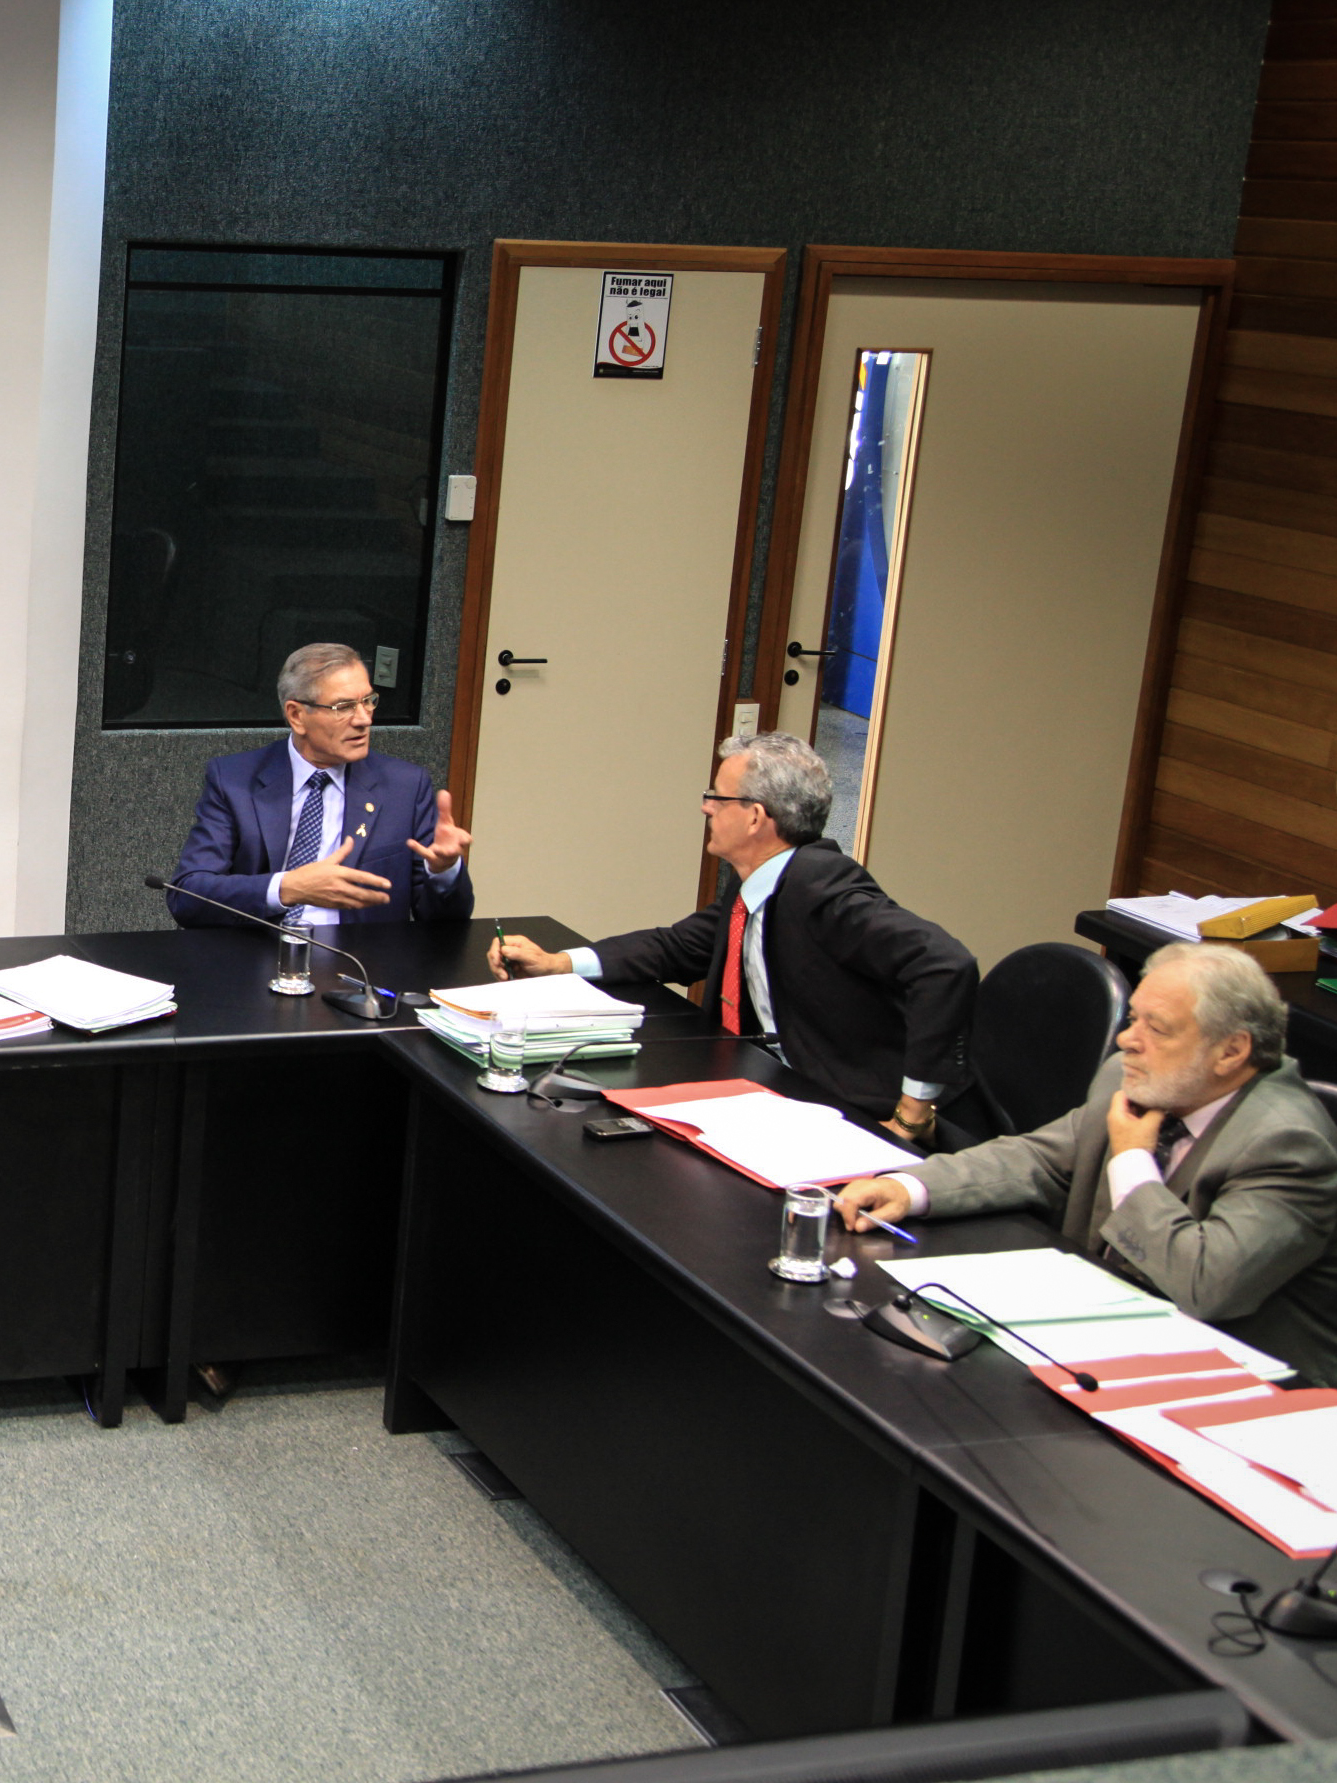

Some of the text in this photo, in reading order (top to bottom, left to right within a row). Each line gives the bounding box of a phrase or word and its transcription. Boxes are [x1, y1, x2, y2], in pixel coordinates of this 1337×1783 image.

[611, 276, 667, 288] Fumar aqui
[610, 286, 666, 297] não é legal
